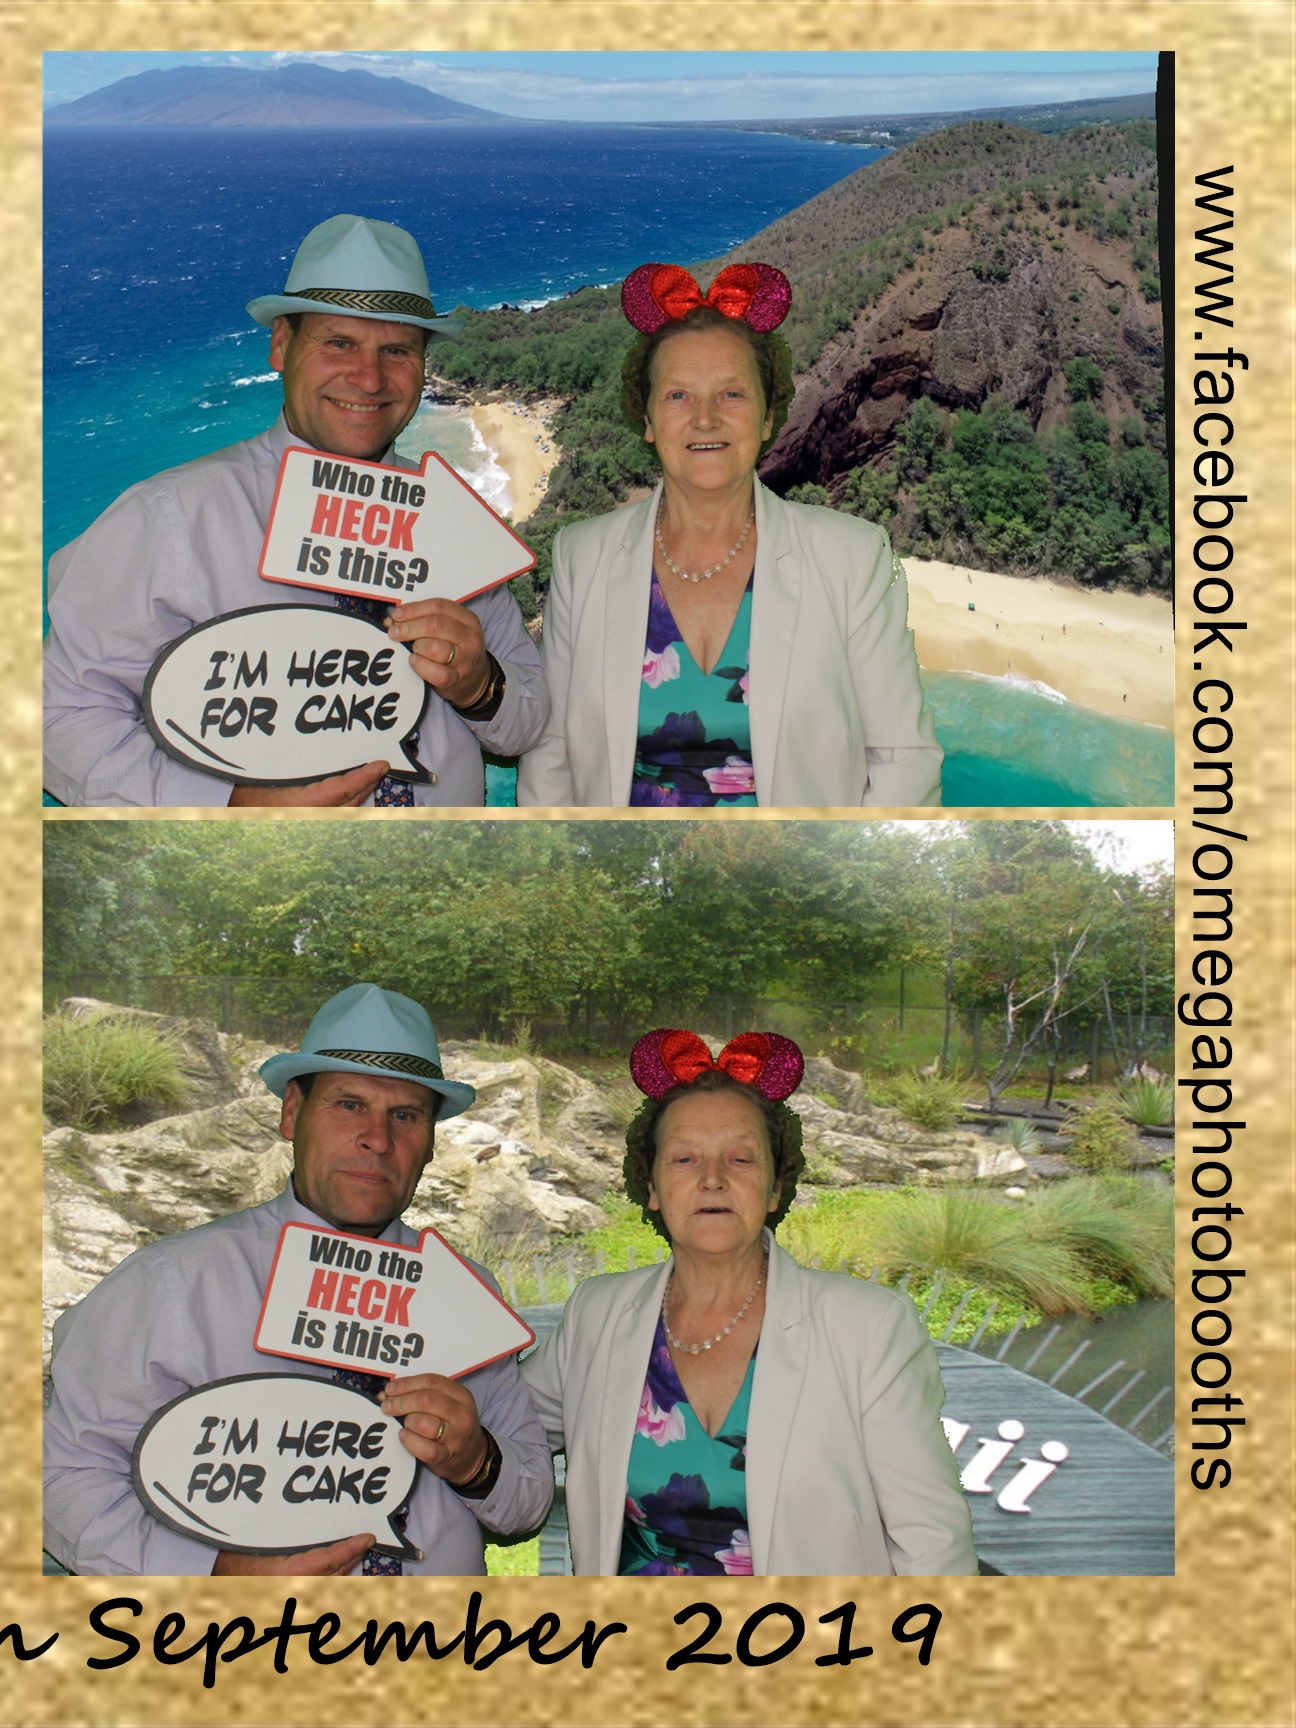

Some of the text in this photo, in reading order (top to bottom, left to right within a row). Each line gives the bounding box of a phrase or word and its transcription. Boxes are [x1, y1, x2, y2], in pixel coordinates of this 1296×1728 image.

[312, 458, 425, 507] Who the
[311, 494, 419, 552] HECK
[297, 537, 428, 591] is this?
[204, 649, 394, 690] I'M HERE
[201, 692, 400, 738] FOR CAKE
[310, 1233, 423, 1283] Who the
[307, 1269, 415, 1326] HECK
[292, 1311, 424, 1366] is this?
[193, 1416, 387, 1459] I'M HERE
[188, 1463, 390, 1504] FOR CAKE
